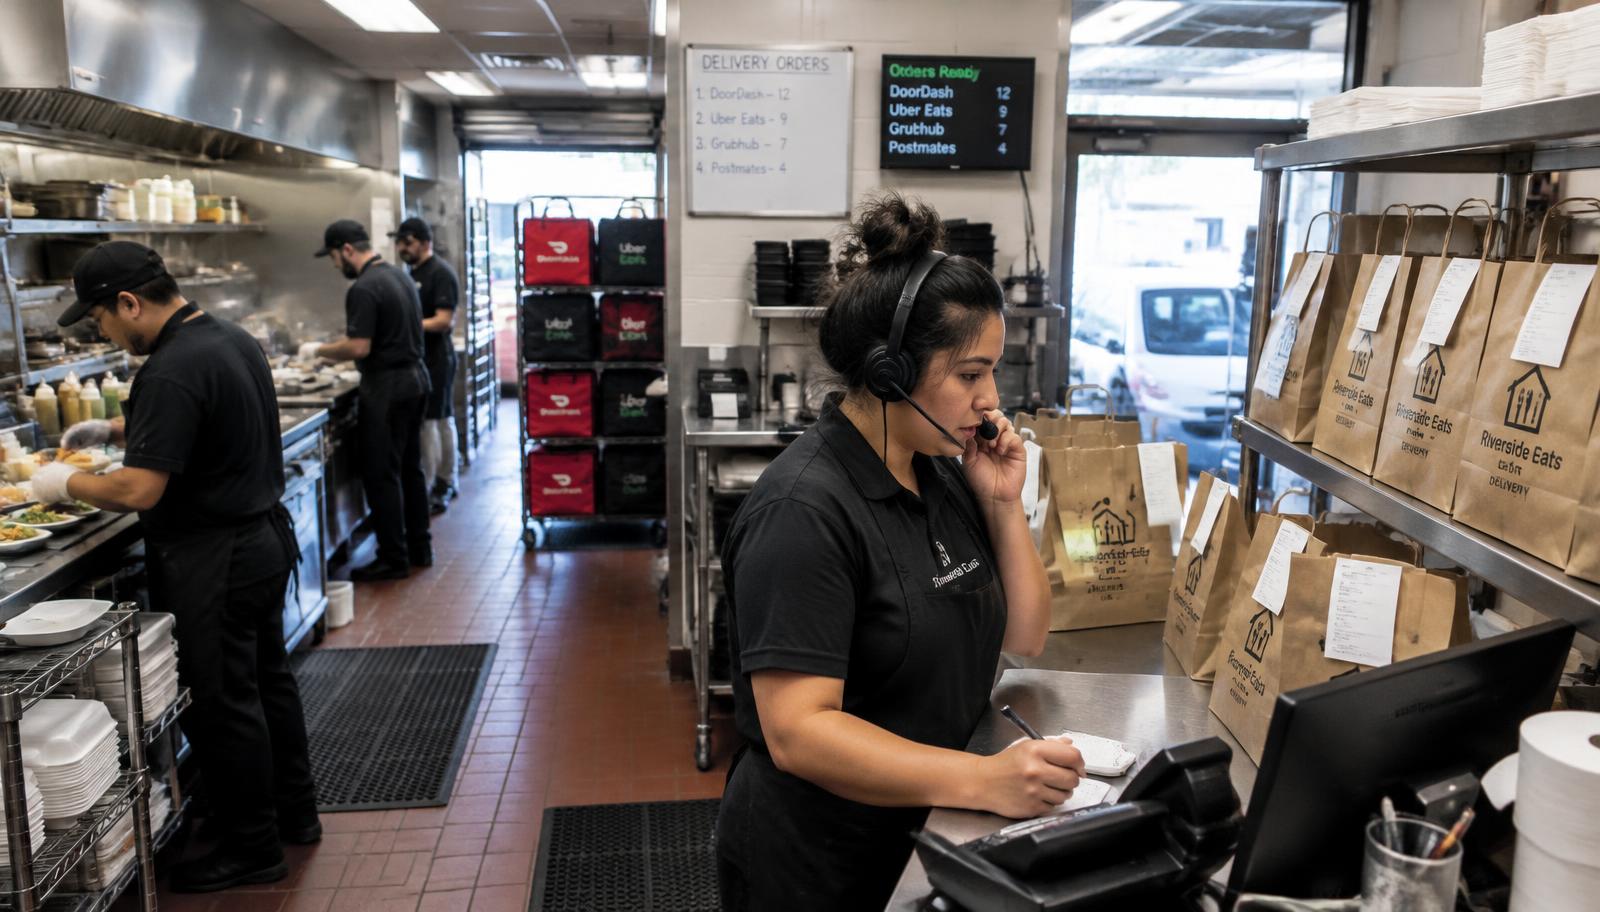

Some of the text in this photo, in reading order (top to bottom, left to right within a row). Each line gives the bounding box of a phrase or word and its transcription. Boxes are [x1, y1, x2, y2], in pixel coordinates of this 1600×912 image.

[703, 54, 830, 71] DELIVERY ORDERS
[710, 86, 764, 100] DoorDash
[778, 87, 790, 100] 12
[889, 84, 1012, 100] DoorDash 12
[889, 103, 1008, 118] Uber Eats 9
[710, 112, 737, 125] Uber
[741, 112, 766, 125] Eats
[780, 112, 788, 125] 9
[998, 124, 1008, 136] 7
[711, 137, 760, 150] Grubhub
[780, 137, 788, 150] 7
[889, 140, 1007, 155] Postmates 4
[779, 162, 786, 174] 4
[1431, 414, 1453, 435] Eats
[1532, 446, 1563, 470] Eats
